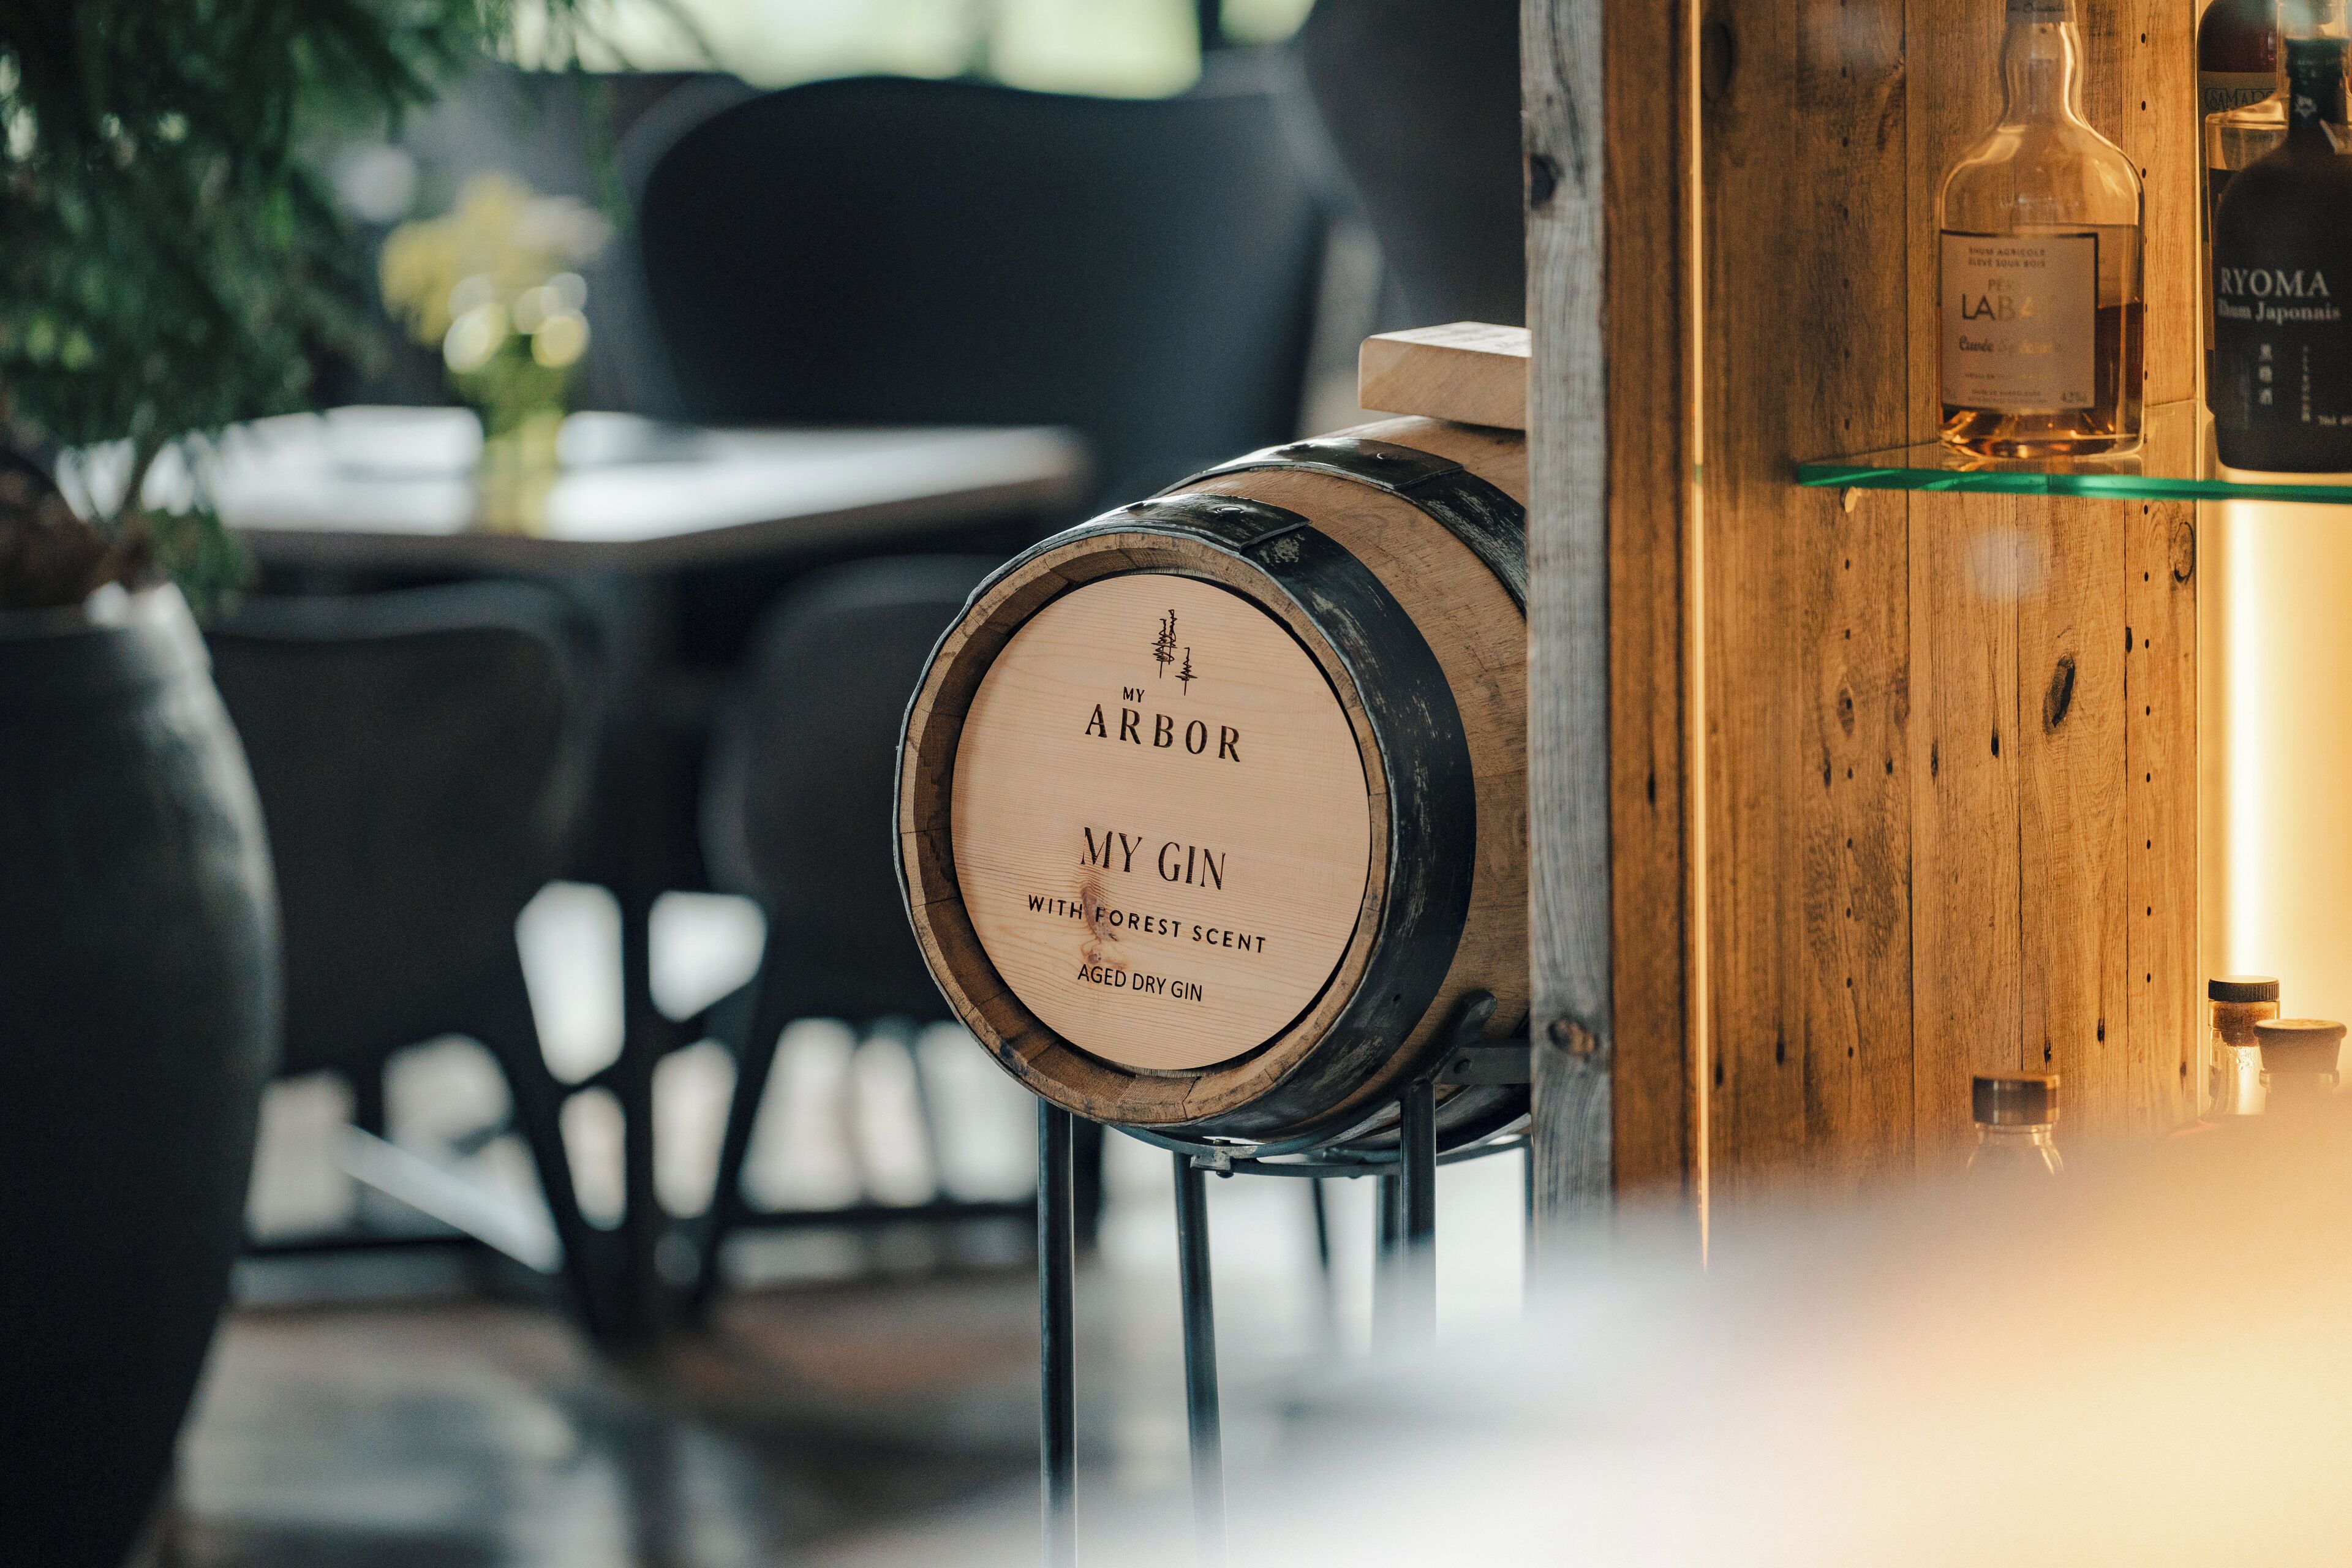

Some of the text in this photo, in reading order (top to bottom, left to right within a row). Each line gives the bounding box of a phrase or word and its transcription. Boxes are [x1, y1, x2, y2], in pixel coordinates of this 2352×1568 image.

[2220, 266, 2331, 297] RYOMA
[2255, 301, 2342, 326] Japonais
[1123, 686, 1145, 703] MY
[1085, 703, 1240, 763] ARBOR
[1080, 826, 1226, 891] MY GIN
[1028, 894, 1266, 954] WITH FOREST SCENT
[1077, 963, 1202, 1002] AGED DRY GIN
